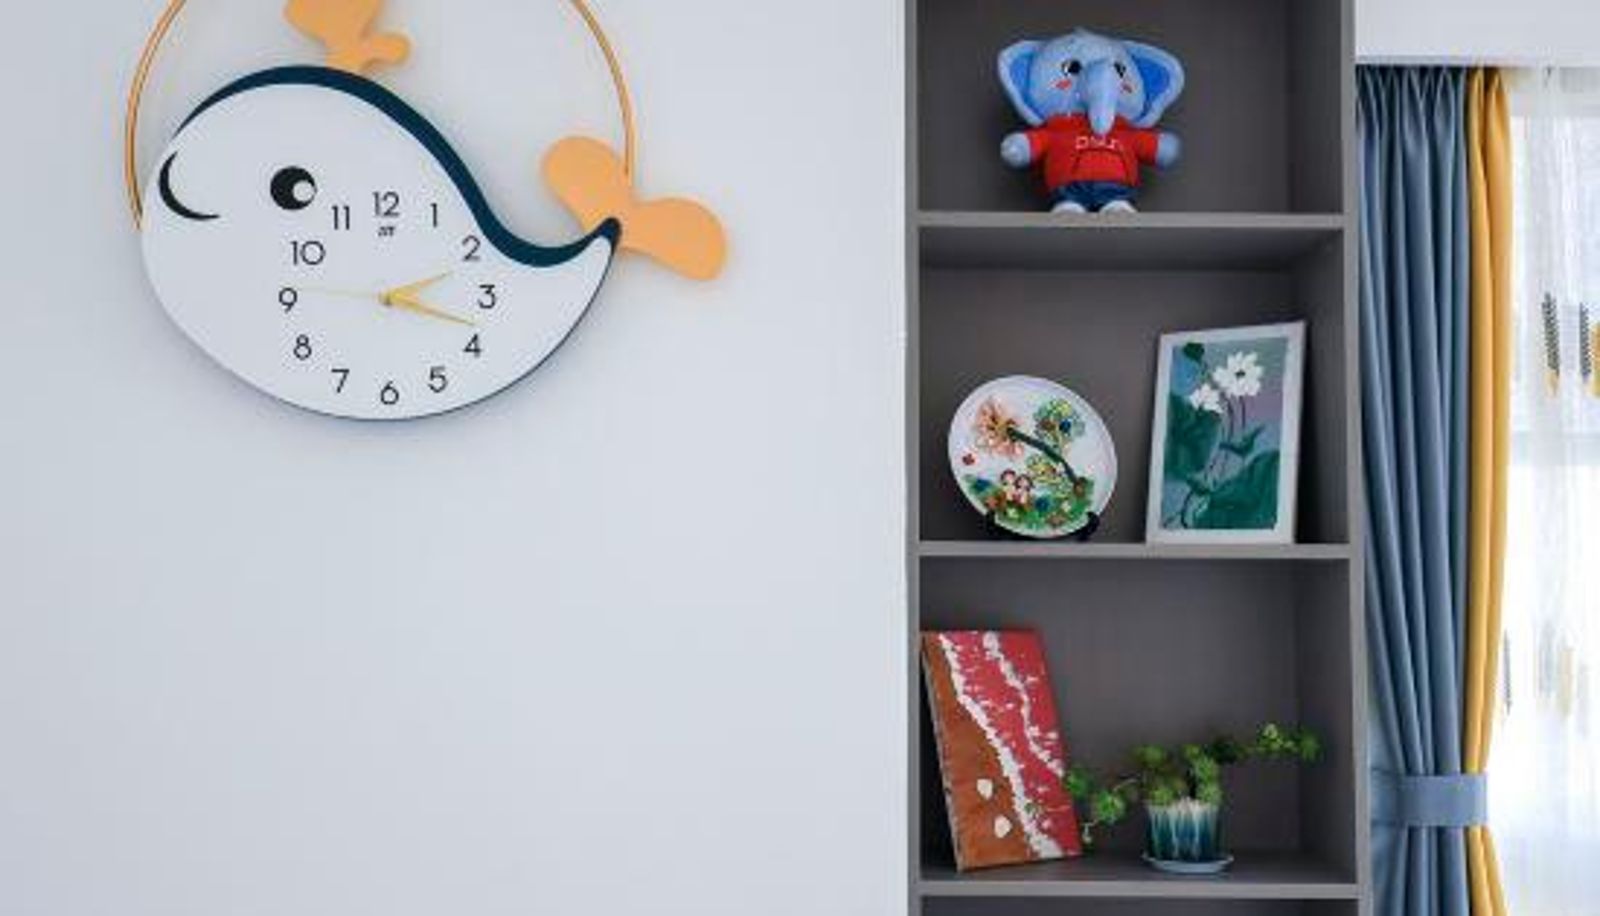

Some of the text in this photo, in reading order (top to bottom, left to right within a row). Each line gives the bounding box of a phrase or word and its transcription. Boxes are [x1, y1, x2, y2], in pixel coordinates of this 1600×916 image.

[373, 191, 399, 216] 12
[430, 203, 438, 227] 1
[331, 205, 350, 230] 11
[290, 240, 326, 266] 10
[462, 235, 481, 260] 2
[278, 287, 298, 312] 9
[478, 284, 496, 309] 3
[293, 334, 312, 360] 8
[463, 333, 482, 357] 4
[331, 368, 350, 393] 7
[428, 366, 447, 393] 5
[380, 380, 400, 405] 6
